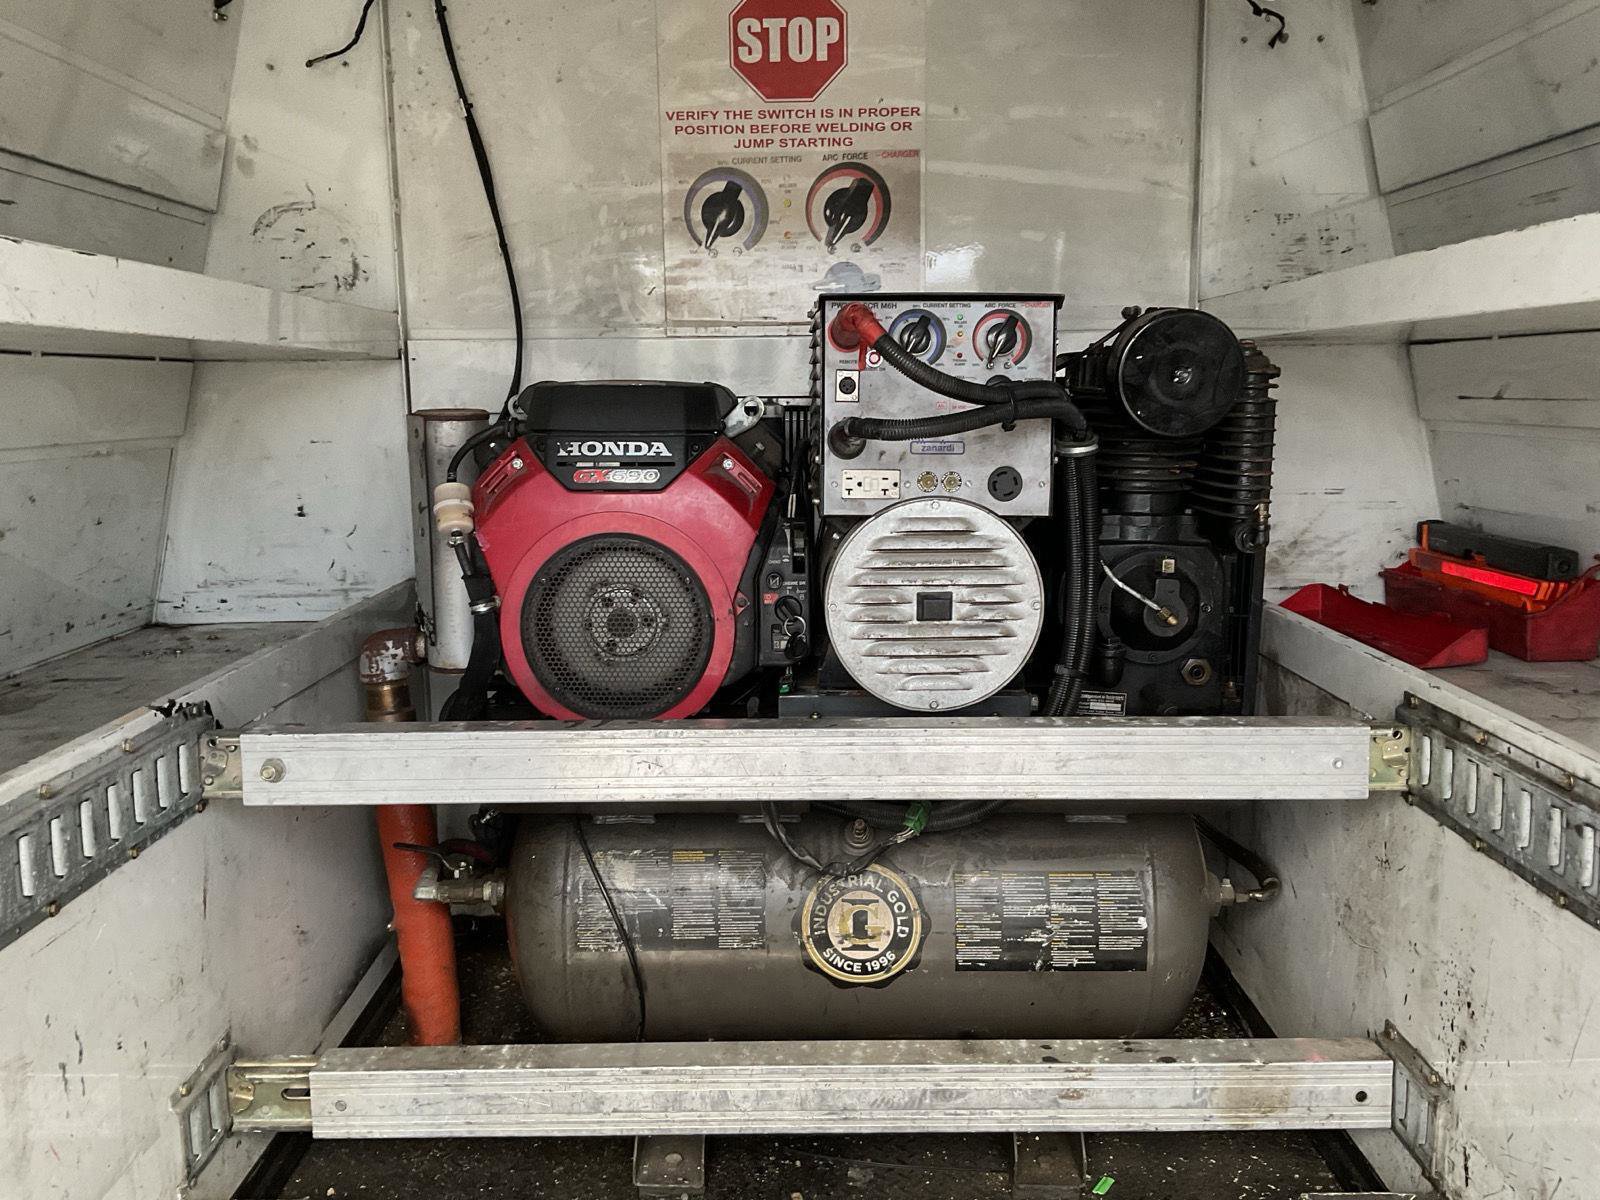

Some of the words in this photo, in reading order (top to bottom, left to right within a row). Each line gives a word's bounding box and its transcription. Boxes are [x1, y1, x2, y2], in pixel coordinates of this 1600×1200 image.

[737, 17, 840, 64] STOP
[665, 110, 720, 121] VERIFY
[723, 109, 753, 120] THE
[757, 108, 816, 120] SWITCH
[820, 108, 834, 119] IS
[839, 108, 853, 118] IN
[858, 106, 921, 118] PROPER
[674, 124, 745, 135] POSITION
[750, 123, 811, 134] BEFORE
[816, 122, 886, 133] WELDING
[890, 121, 913, 131] OR
[733, 138, 775, 149] JUMP
[779, 137, 854, 148] STARTING
[731, 156, 768, 165] CURRENT
[770, 155, 802, 164] SETTING
[821, 153, 839, 161] ARC
[842, 152, 869, 161] FORCE
[556, 441, 673, 457] HONDA
[921, 443, 955, 452] zanardi
[887, 890, 910, 939] GOLD
[822, 947, 862, 973] SINCE
[865, 950, 896, 972] 1996
